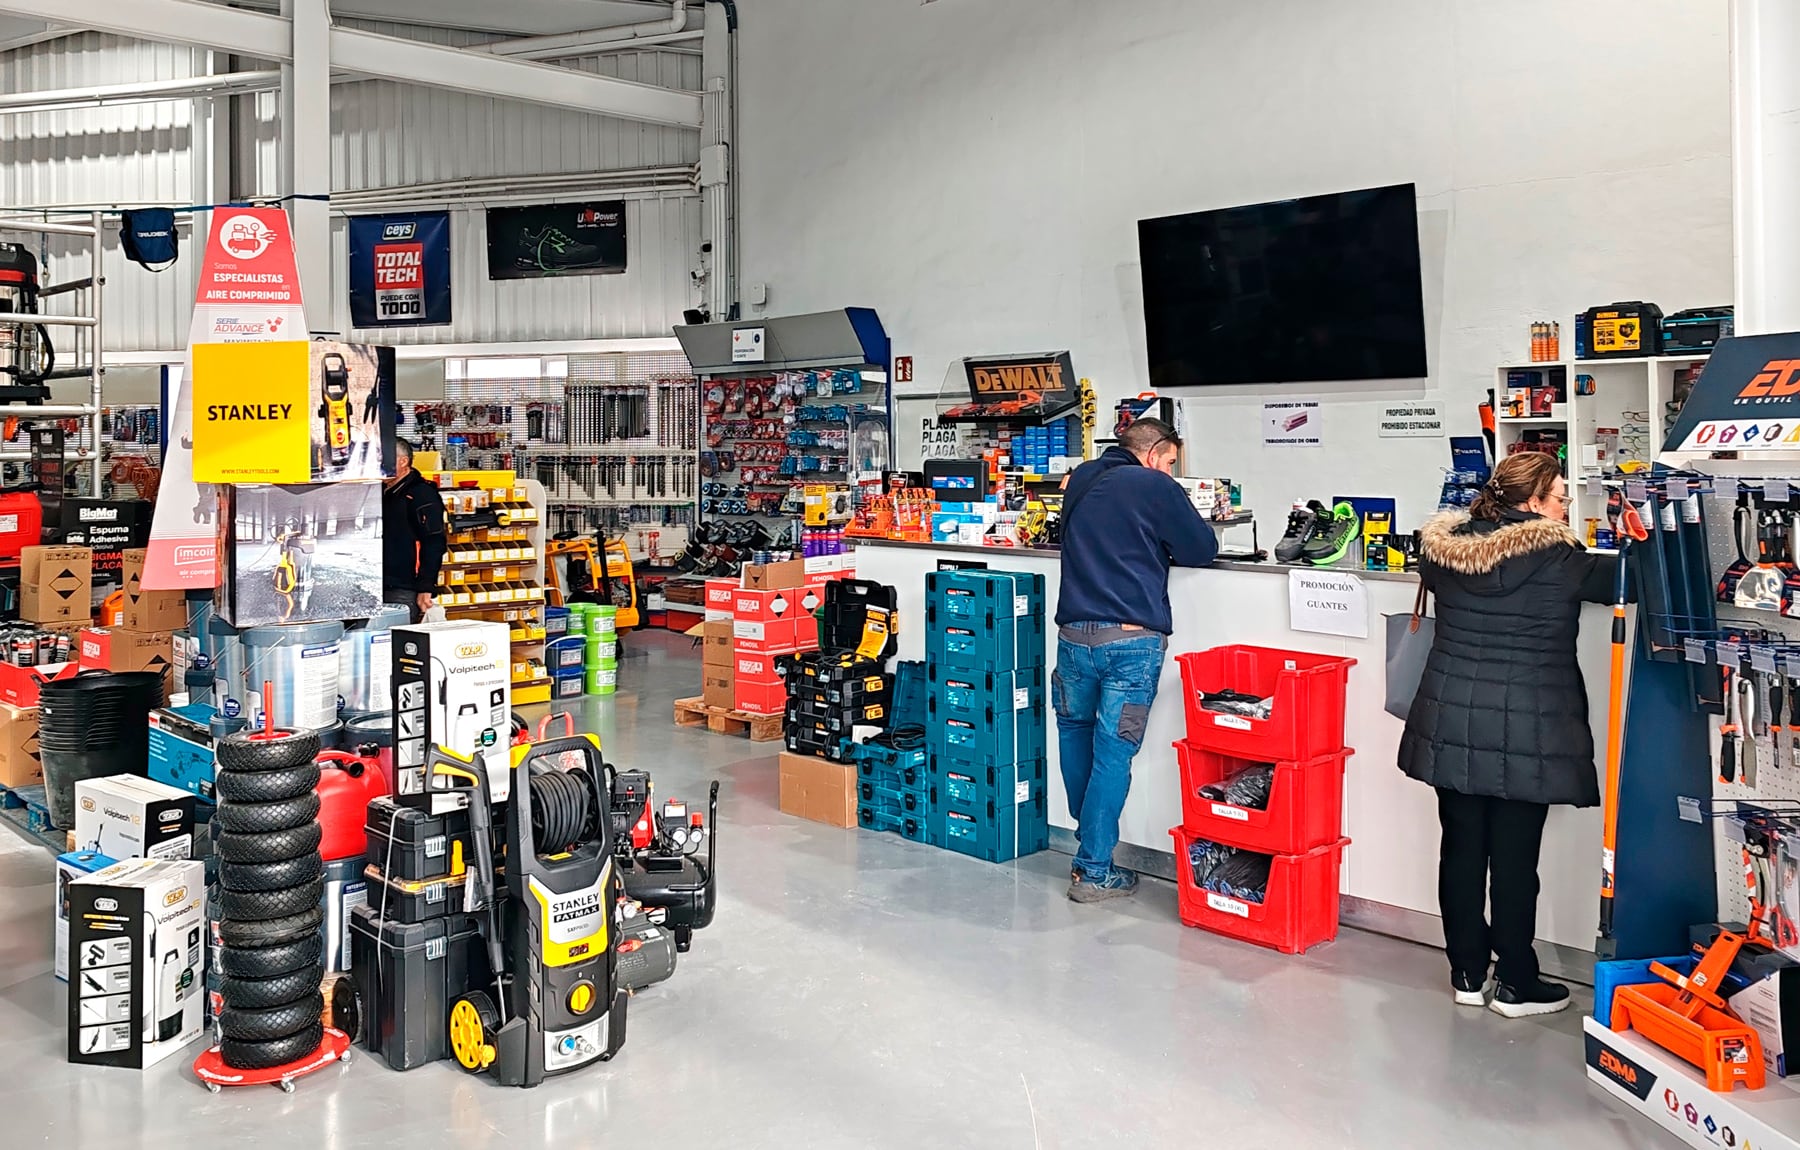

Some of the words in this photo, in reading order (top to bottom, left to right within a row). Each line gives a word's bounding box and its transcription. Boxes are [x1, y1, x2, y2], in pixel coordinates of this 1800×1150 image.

[386, 224, 412, 237] ceys
[377, 251, 421, 267] TOTAL
[214, 262, 237, 270] Somos
[213, 273, 284, 283] ESPECIALISTAS
[377, 268, 418, 283] TECH
[206, 290, 229, 300] AIRE
[230, 290, 291, 301] COMPRIMIDO
[381, 301, 421, 316] TODO
[214, 324, 264, 332] ADVANCE
[1756, 396, 1792, 404] OUTIL
[207, 404, 292, 421] STANLEY
[1386, 408, 1413, 417] PROPIEDAD
[1414, 408, 1436, 416] PRIVADA
[1381, 422, 1408, 430] PROHIBIDO
[1409, 421, 1441, 430] ESTACIONAR
[922, 431, 957, 443] PLAGA
[921, 444, 956, 458] PLAGA
[79, 507, 118, 521] BigMat
[89, 526, 130, 536] Espuma
[89, 535, 129, 544] Adhesiva
[812, 574, 835, 583] PENOSIL
[1301, 580, 1355, 592] PROMOCIÓN
[1306, 600, 1348, 611] GUANTES
[448, 663, 496, 674] Volpitech
[103, 806, 131, 824] Volpitech
[552, 892, 600, 913] STANLEY
[157, 904, 194, 925] Volpitech
[555, 905, 598, 923] FATMAX
[1599, 1049, 1638, 1083] EDMA
